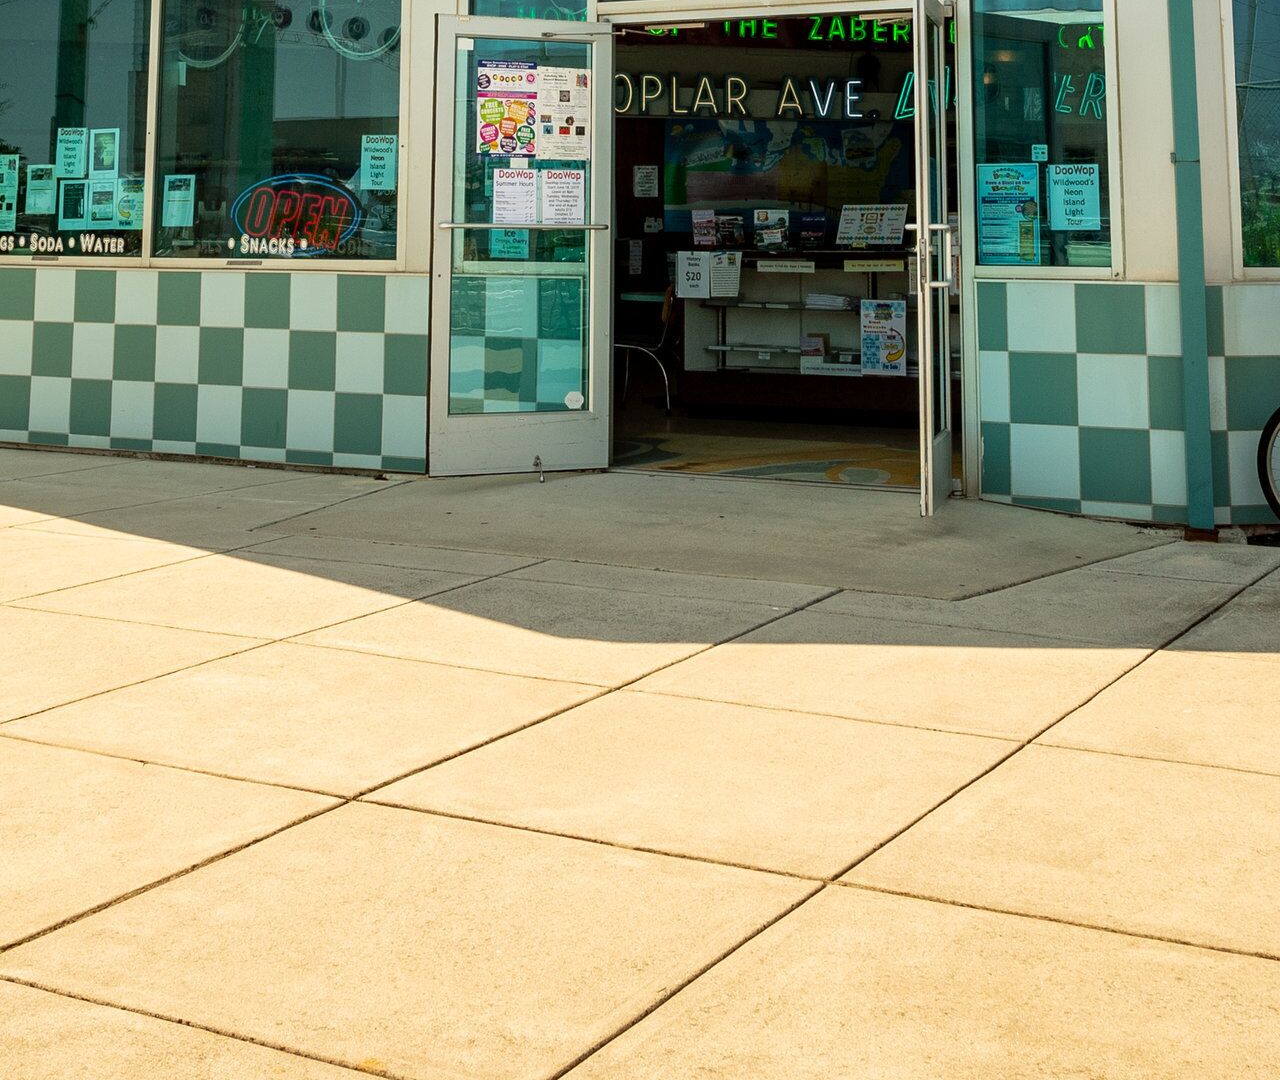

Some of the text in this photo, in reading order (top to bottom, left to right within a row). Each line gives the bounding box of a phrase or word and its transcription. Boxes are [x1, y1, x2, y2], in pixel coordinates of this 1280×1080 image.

[60, 128, 84, 136] DooWop
[366, 135, 395, 145] DooWop
[498, 169, 534, 180] DooWop
[547, 170, 582, 181] DooWop
[1055, 165, 1095, 176] DooWop
[1053, 178, 1095, 186] Wildwood's
[1063, 198, 1086, 206] Island
[1064, 208, 1084, 217] Light
[245, 186, 348, 251] OPEN
[1066, 218, 1083, 226] Tour
[504, 229, 516, 237] Ice
[30, 233, 64, 253] SODA
[80, 233, 125, 254] WATER
[240, 233, 295, 254] SNACKS
[685, 271, 702, 282] $20
